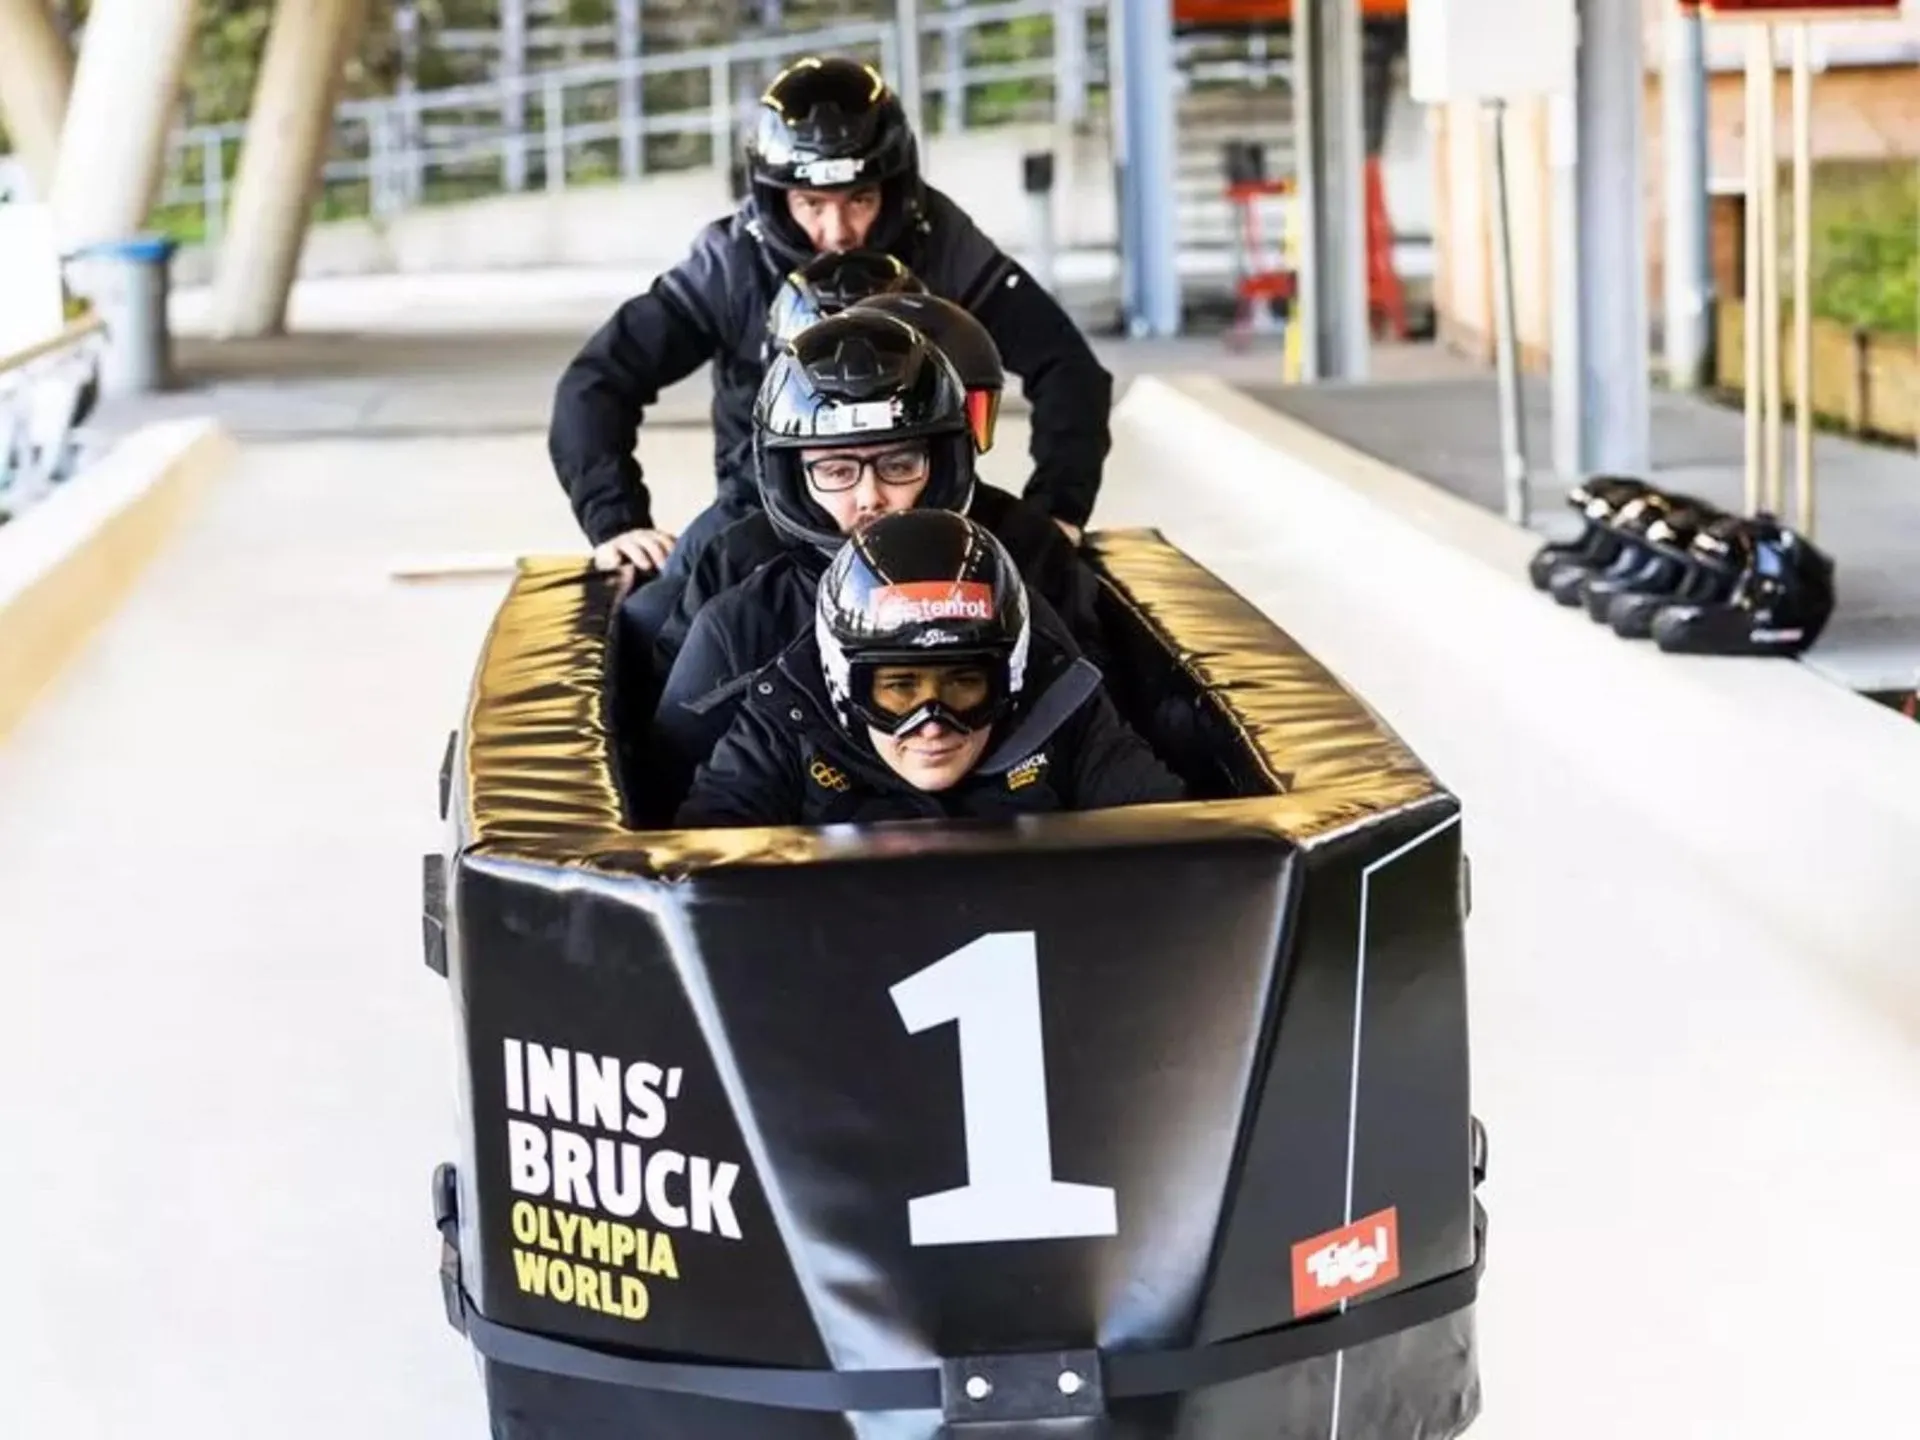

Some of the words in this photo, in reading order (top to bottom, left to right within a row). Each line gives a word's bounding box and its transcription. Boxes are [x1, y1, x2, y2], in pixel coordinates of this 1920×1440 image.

[880, 594, 988, 620] stenrot
[503, 1038, 683, 1139] INNS'
[889, 931, 1118, 1246] 1
[507, 1119, 743, 1240] BRUCK
[512, 1201, 679, 1279] OLYMPIA
[513, 1248, 649, 1319] WORLD
